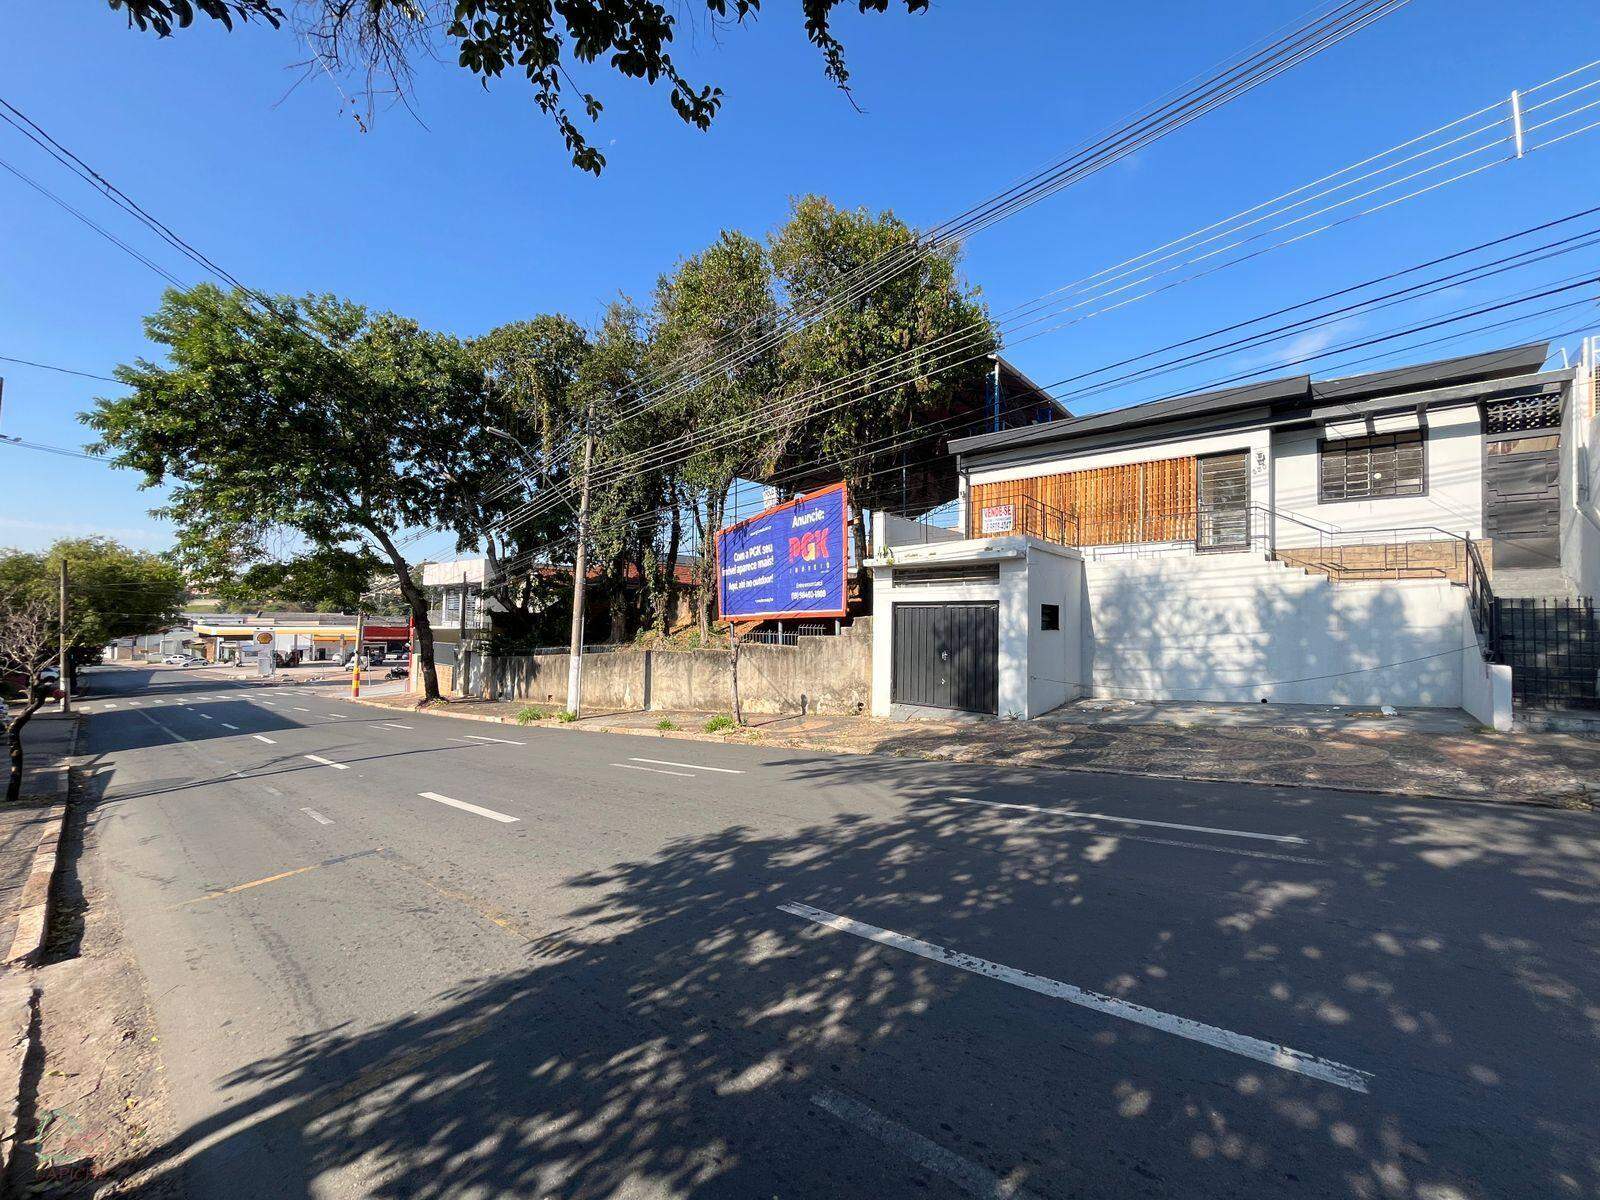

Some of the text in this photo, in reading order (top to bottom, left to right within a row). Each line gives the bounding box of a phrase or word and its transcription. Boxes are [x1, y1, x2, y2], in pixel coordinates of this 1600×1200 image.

[792, 508, 824, 527] Anuncie:
[984, 506, 1012, 517] VENDE-SE
[789, 528, 829, 562] PGK
